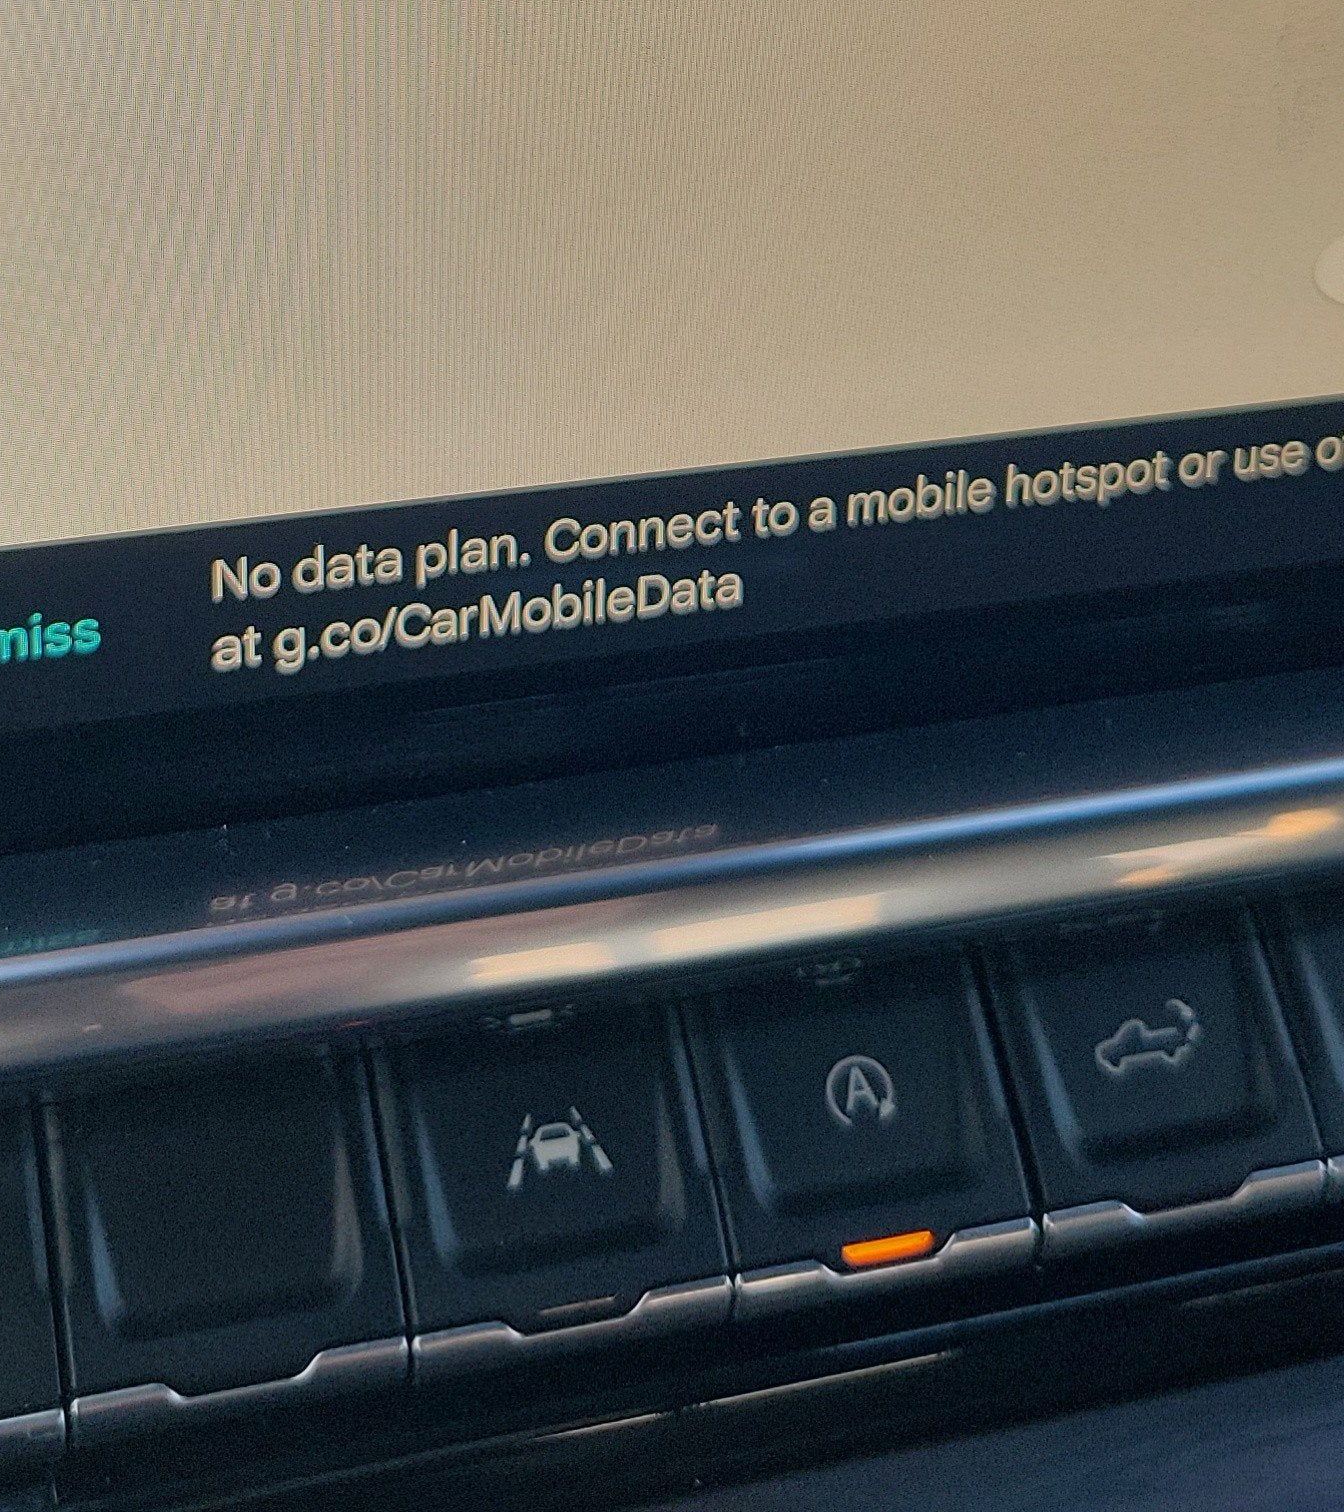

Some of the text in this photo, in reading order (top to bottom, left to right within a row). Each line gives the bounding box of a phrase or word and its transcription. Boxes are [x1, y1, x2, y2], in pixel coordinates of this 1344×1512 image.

[211, 555, 282, 604] No
[291, 543, 404, 595] data
[414, 528, 533, 589] plan.
[544, 497, 741, 563] Connect
[752, 495, 797, 538] to
[807, 494, 838, 532] a
[846, 469, 996, 526] mobile
[1005, 449, 1173, 506] hotspot
[1177, 449, 1227, 487] or
[1233, 439, 1312, 481] use
[210, 568, 744, 675] at g.co/CarMobileData
